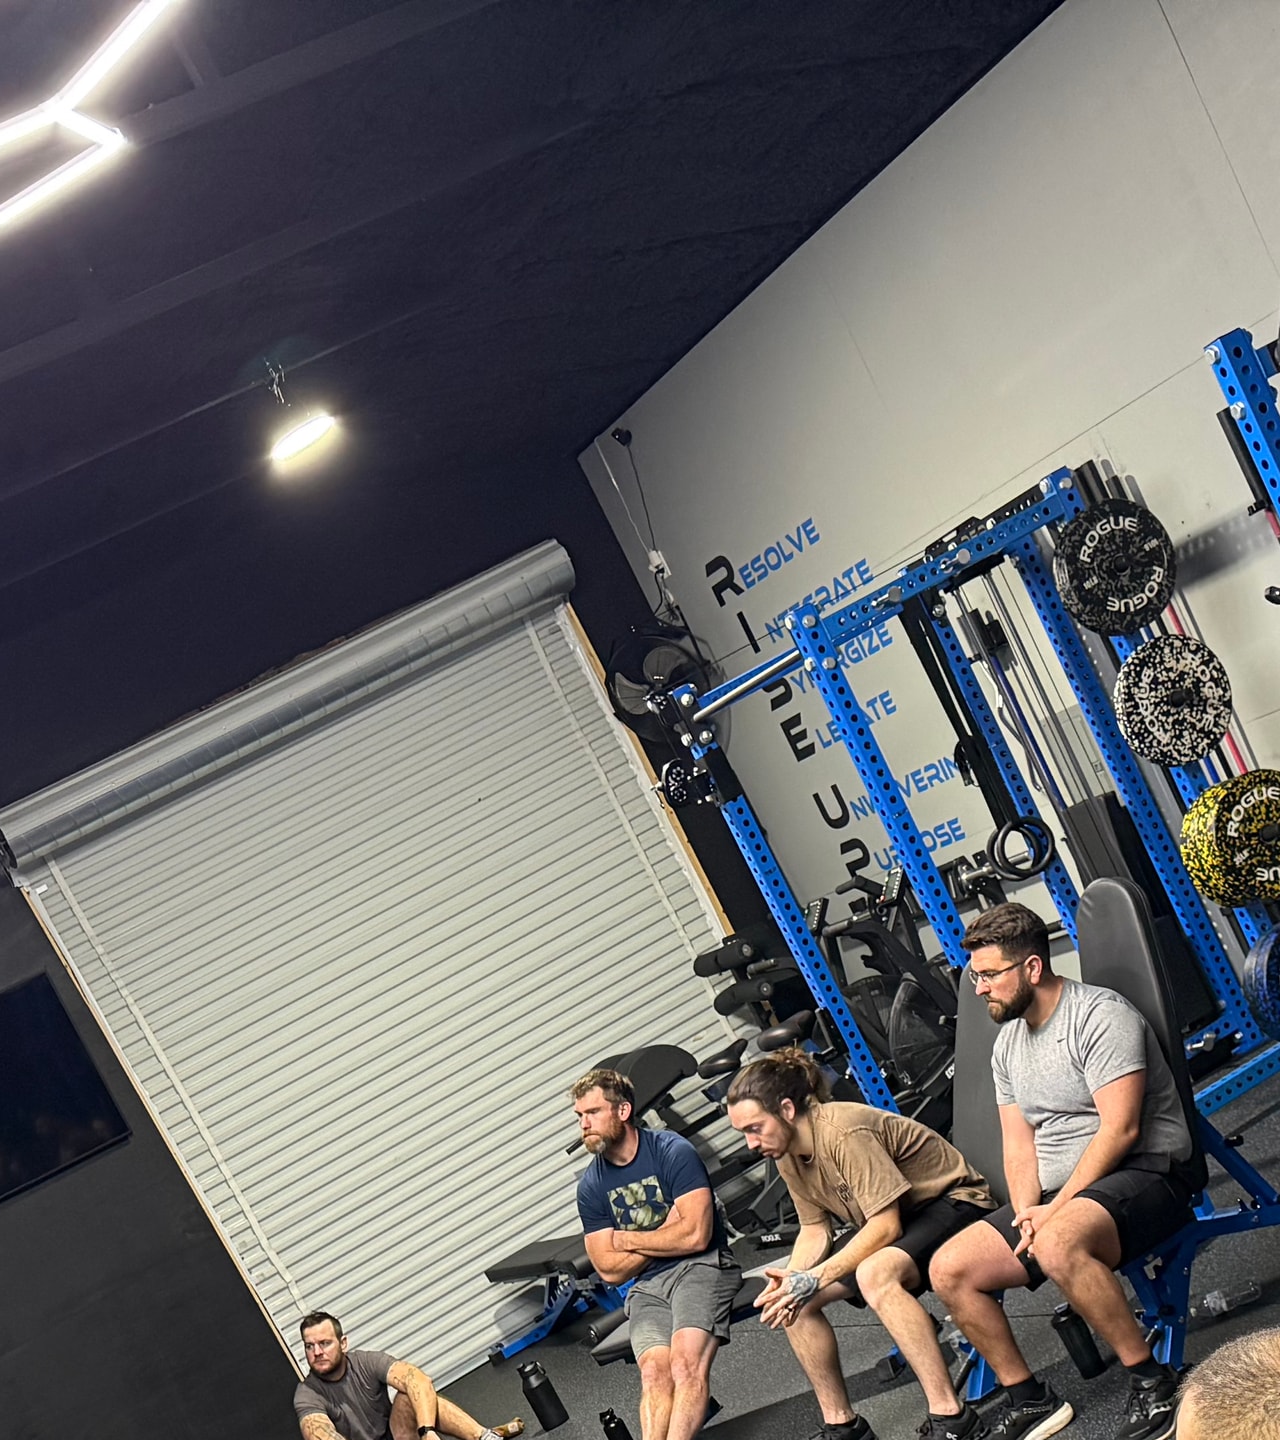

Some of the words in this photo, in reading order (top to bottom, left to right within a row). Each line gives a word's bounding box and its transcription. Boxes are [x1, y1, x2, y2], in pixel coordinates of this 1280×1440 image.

[705, 517, 820, 608] RESOLVE
[1080, 515, 1138, 563] ROGUE
[1106, 565, 1164, 613] ROGUE
[1227, 786, 1280, 838] ROGUE
